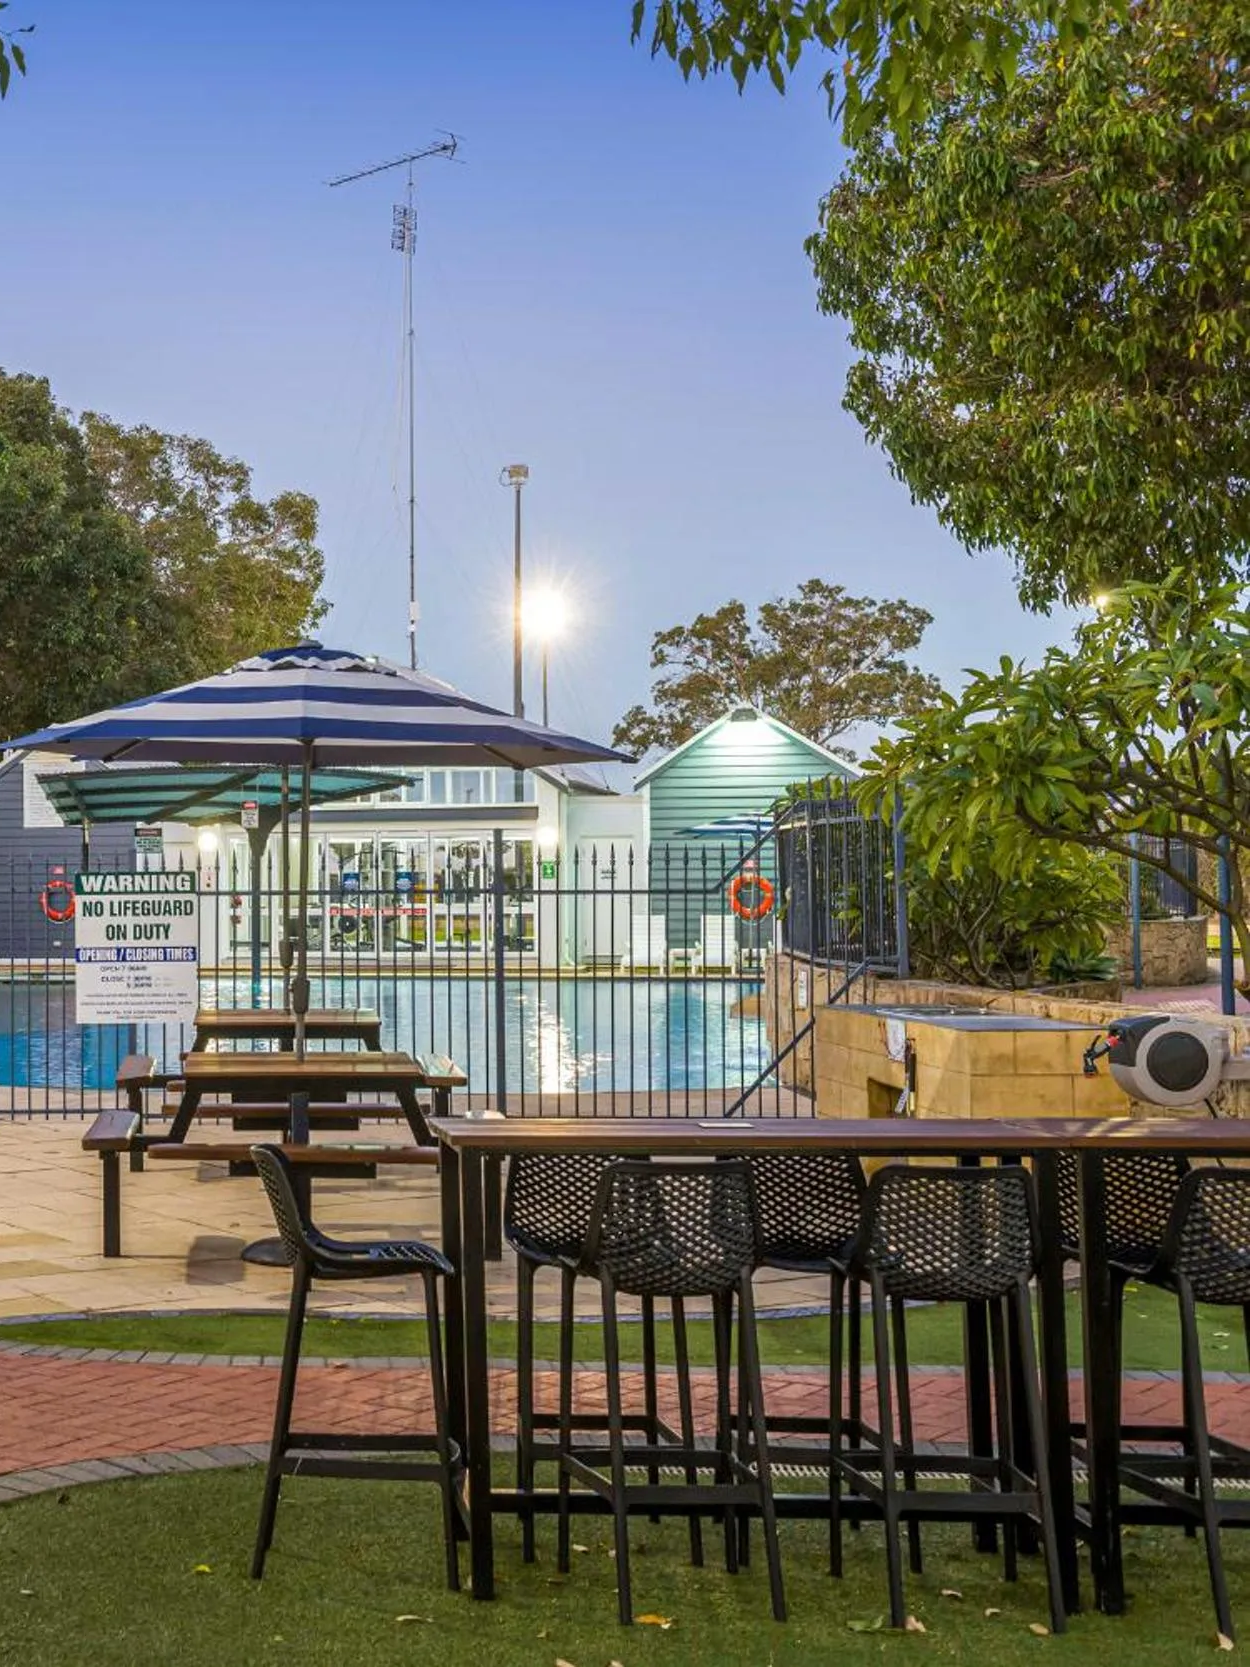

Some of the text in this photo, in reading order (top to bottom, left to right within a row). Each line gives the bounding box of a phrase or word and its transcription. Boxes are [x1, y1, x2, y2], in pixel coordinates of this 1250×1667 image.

[80, 874, 191, 892] WARNING
[82, 900, 194, 917] NO LIFEGUARD
[105, 923, 171, 941] ON DUTY
[79, 948, 118, 961] OPENING
[126, 948, 164, 961] CLOSING
[165, 948, 194, 960] TIMES
